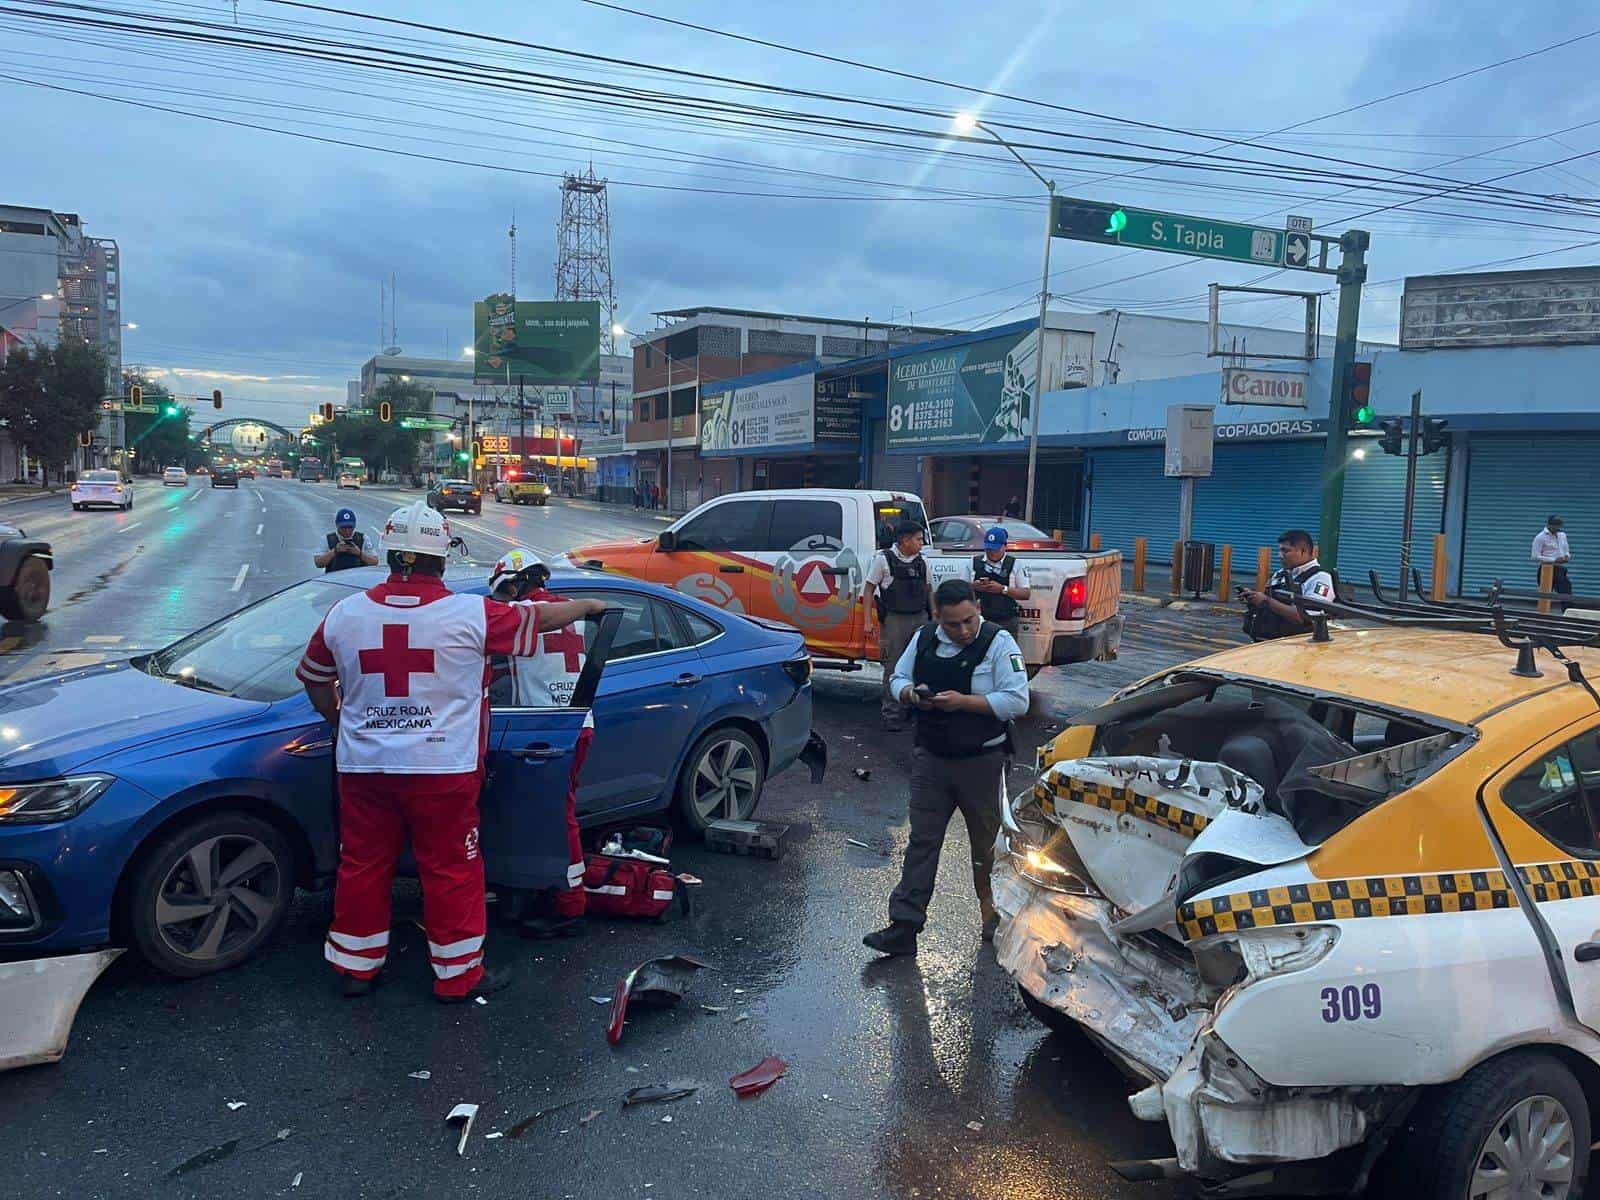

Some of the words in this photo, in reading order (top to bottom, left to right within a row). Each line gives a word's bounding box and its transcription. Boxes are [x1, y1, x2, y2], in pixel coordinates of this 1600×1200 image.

[1151, 221, 1167, 241] S.
[1232, 373, 1303, 398] Canon
[890, 403, 914, 432] 81
[732, 419, 746, 445] 81
[1217, 420, 1312, 438] COPIADORAS
[549, 681, 575, 691] CRUZ
[366, 706, 397, 717] CRUZ
[400, 705, 432, 716] ROJA
[366, 719, 432, 729] MEXICANA
[1321, 983, 1382, 1023] 309
